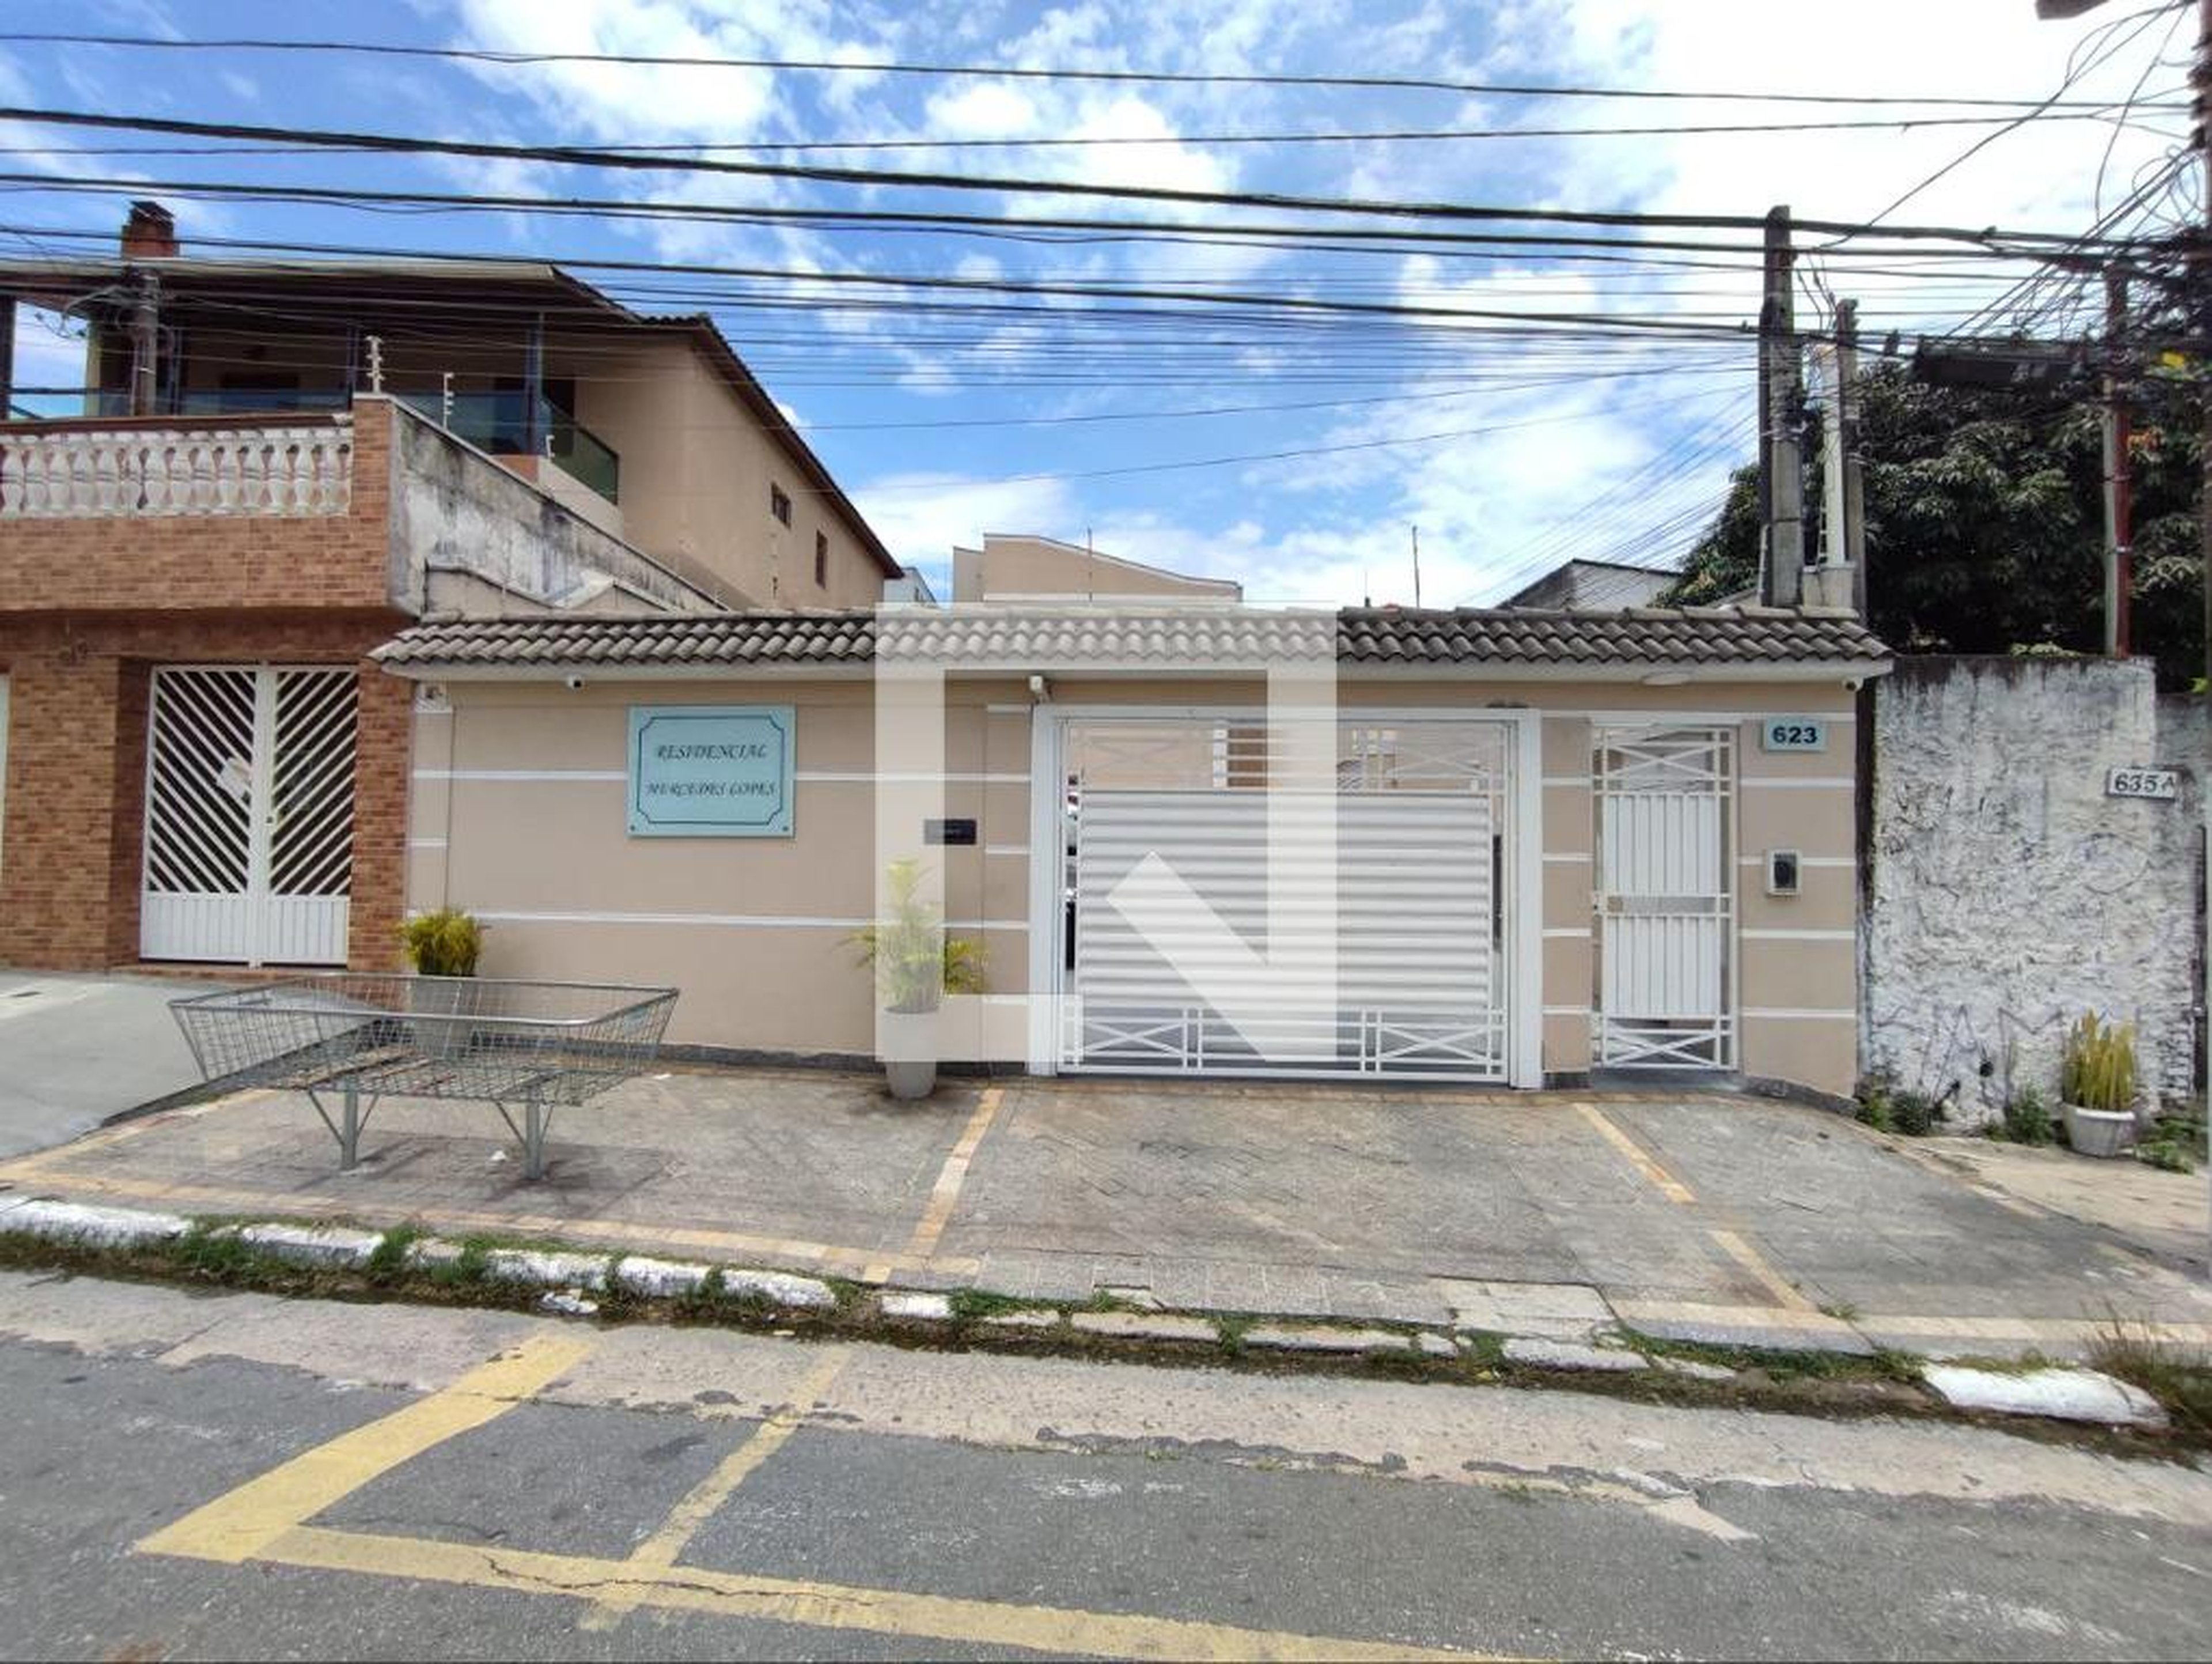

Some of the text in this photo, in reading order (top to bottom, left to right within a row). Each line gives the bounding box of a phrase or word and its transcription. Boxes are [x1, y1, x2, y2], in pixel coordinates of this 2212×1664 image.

[1772, 726, 1818, 744] 623
[657, 744, 768, 760] RESIDENCIAL
[729, 781, 776, 796] LOPES
